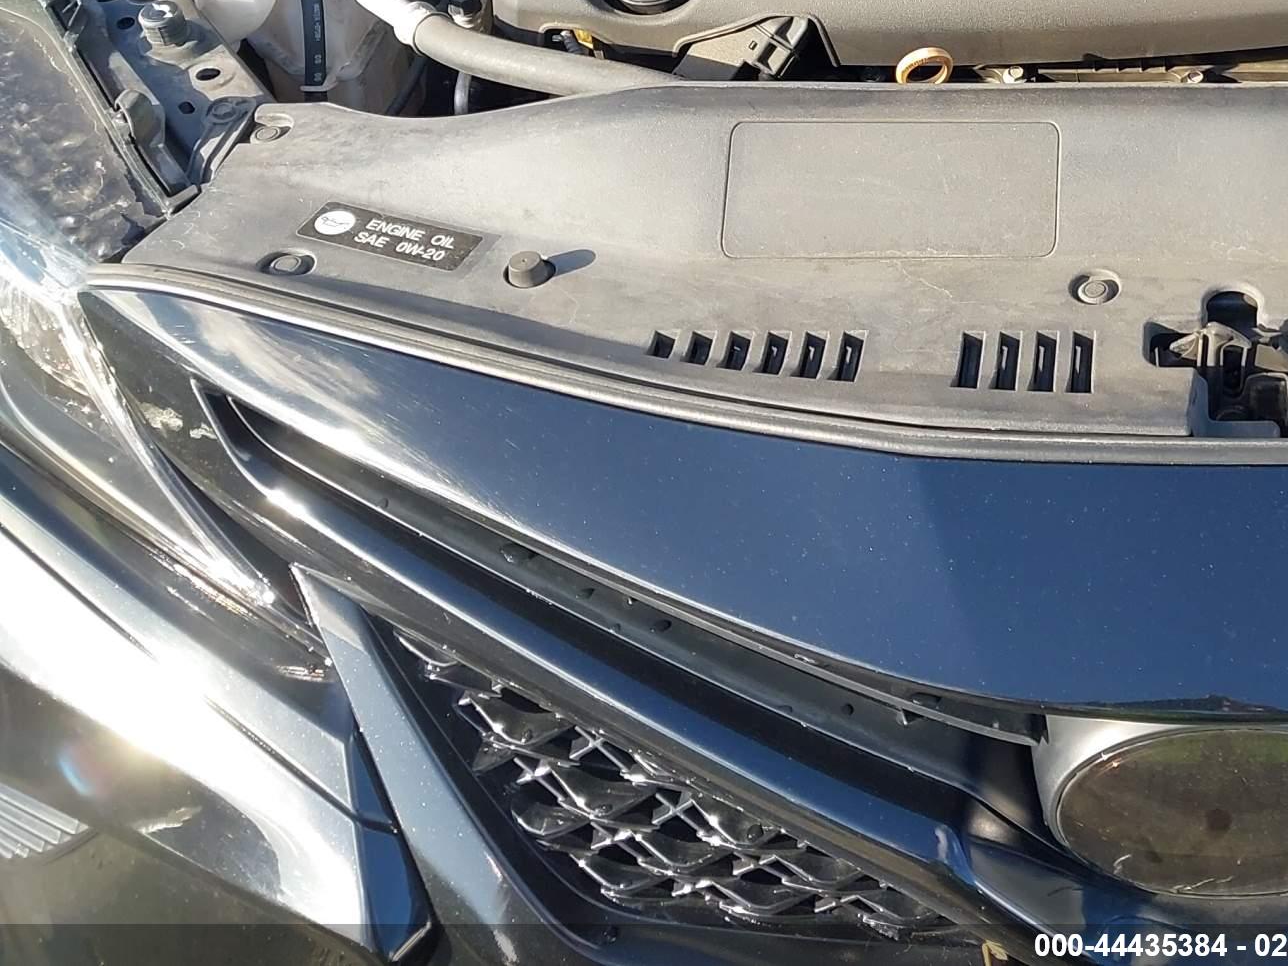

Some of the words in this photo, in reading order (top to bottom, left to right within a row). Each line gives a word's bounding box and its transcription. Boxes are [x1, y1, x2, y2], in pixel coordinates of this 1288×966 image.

[354, 231, 391, 249] SAE
[395, 241, 446, 262] 0W-20
[365, 218, 426, 242] ENGINE
[430, 234, 456, 250] OIL
